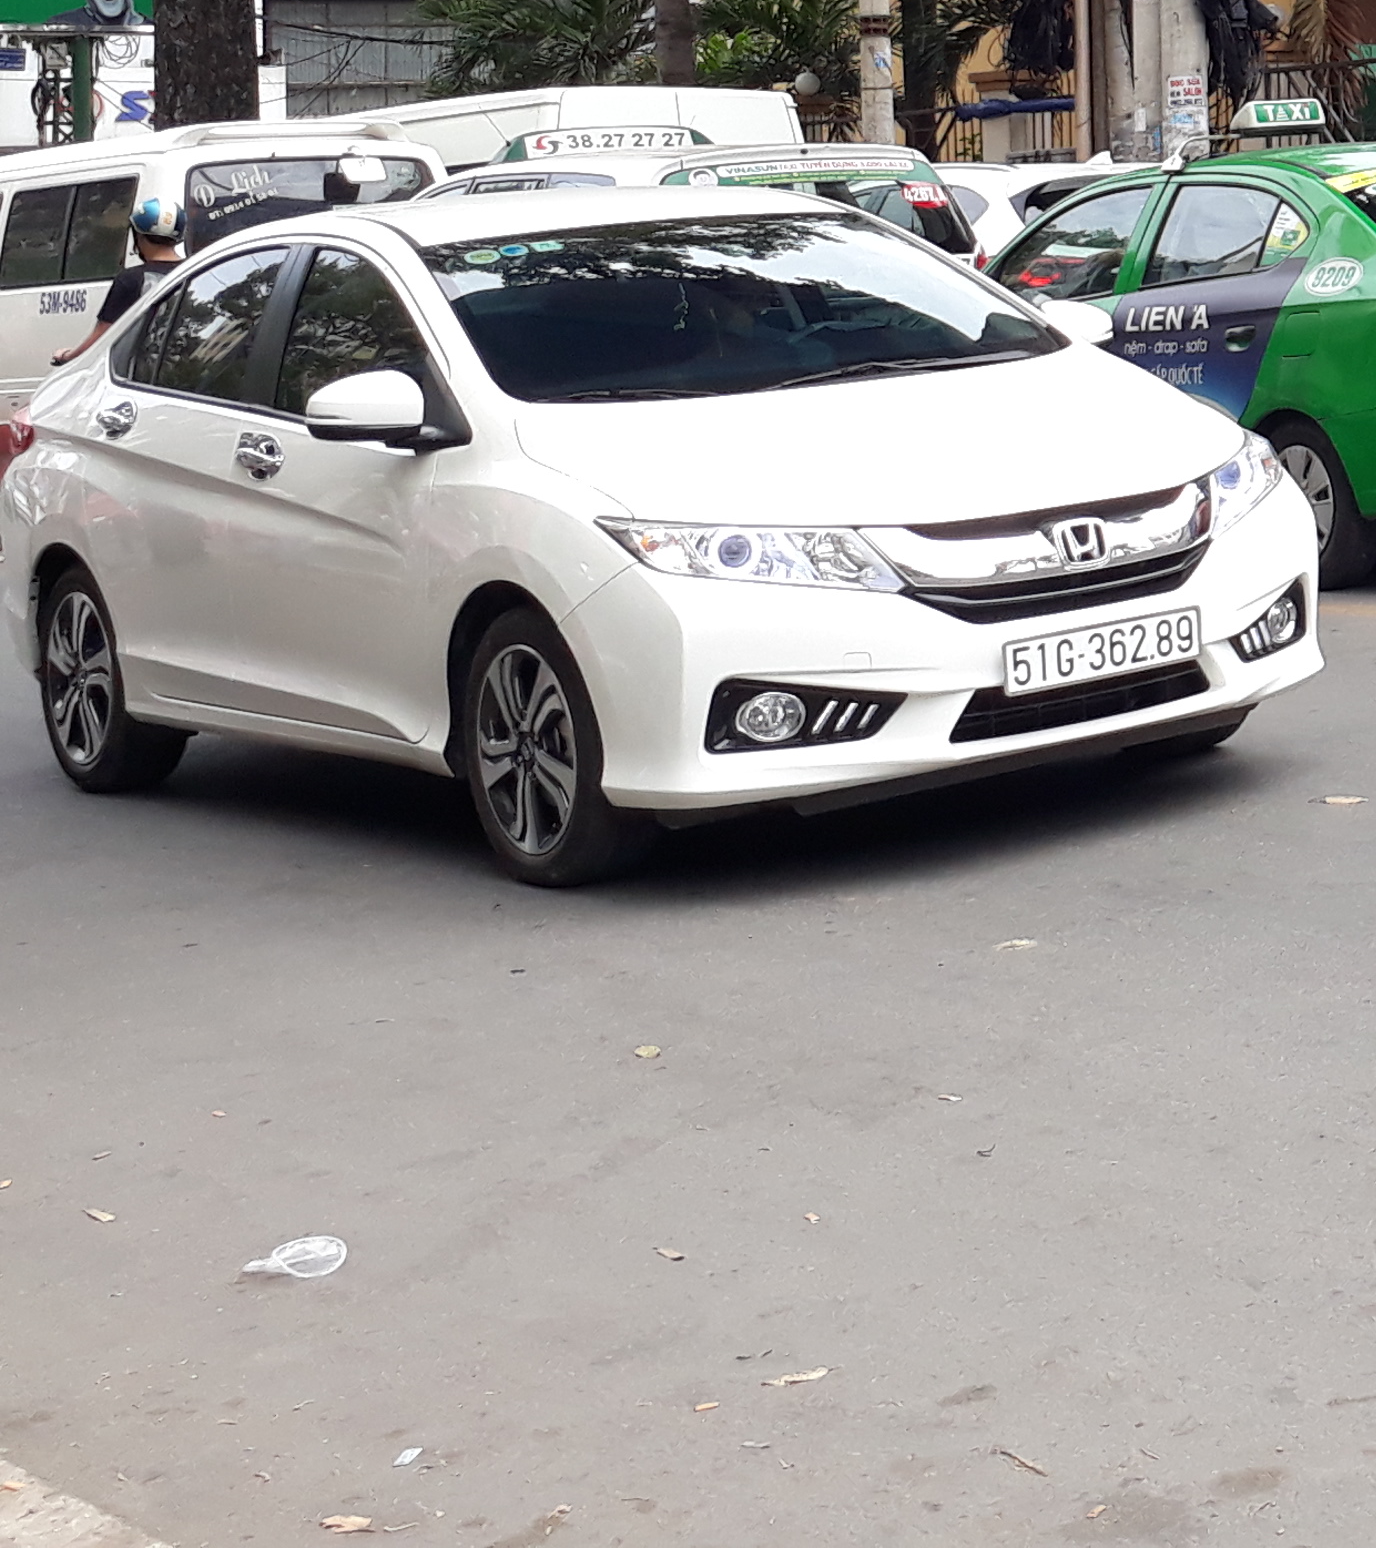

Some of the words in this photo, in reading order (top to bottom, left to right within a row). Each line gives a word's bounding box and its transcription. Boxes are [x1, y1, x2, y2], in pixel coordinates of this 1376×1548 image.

[566, 133, 625, 149] 38.27
[631, 132, 655, 147] 27
[661, 132, 685, 147] 27
[1311, 265, 1357, 288] 9209
[1012, 614, 1194, 686] 51G-362.89
